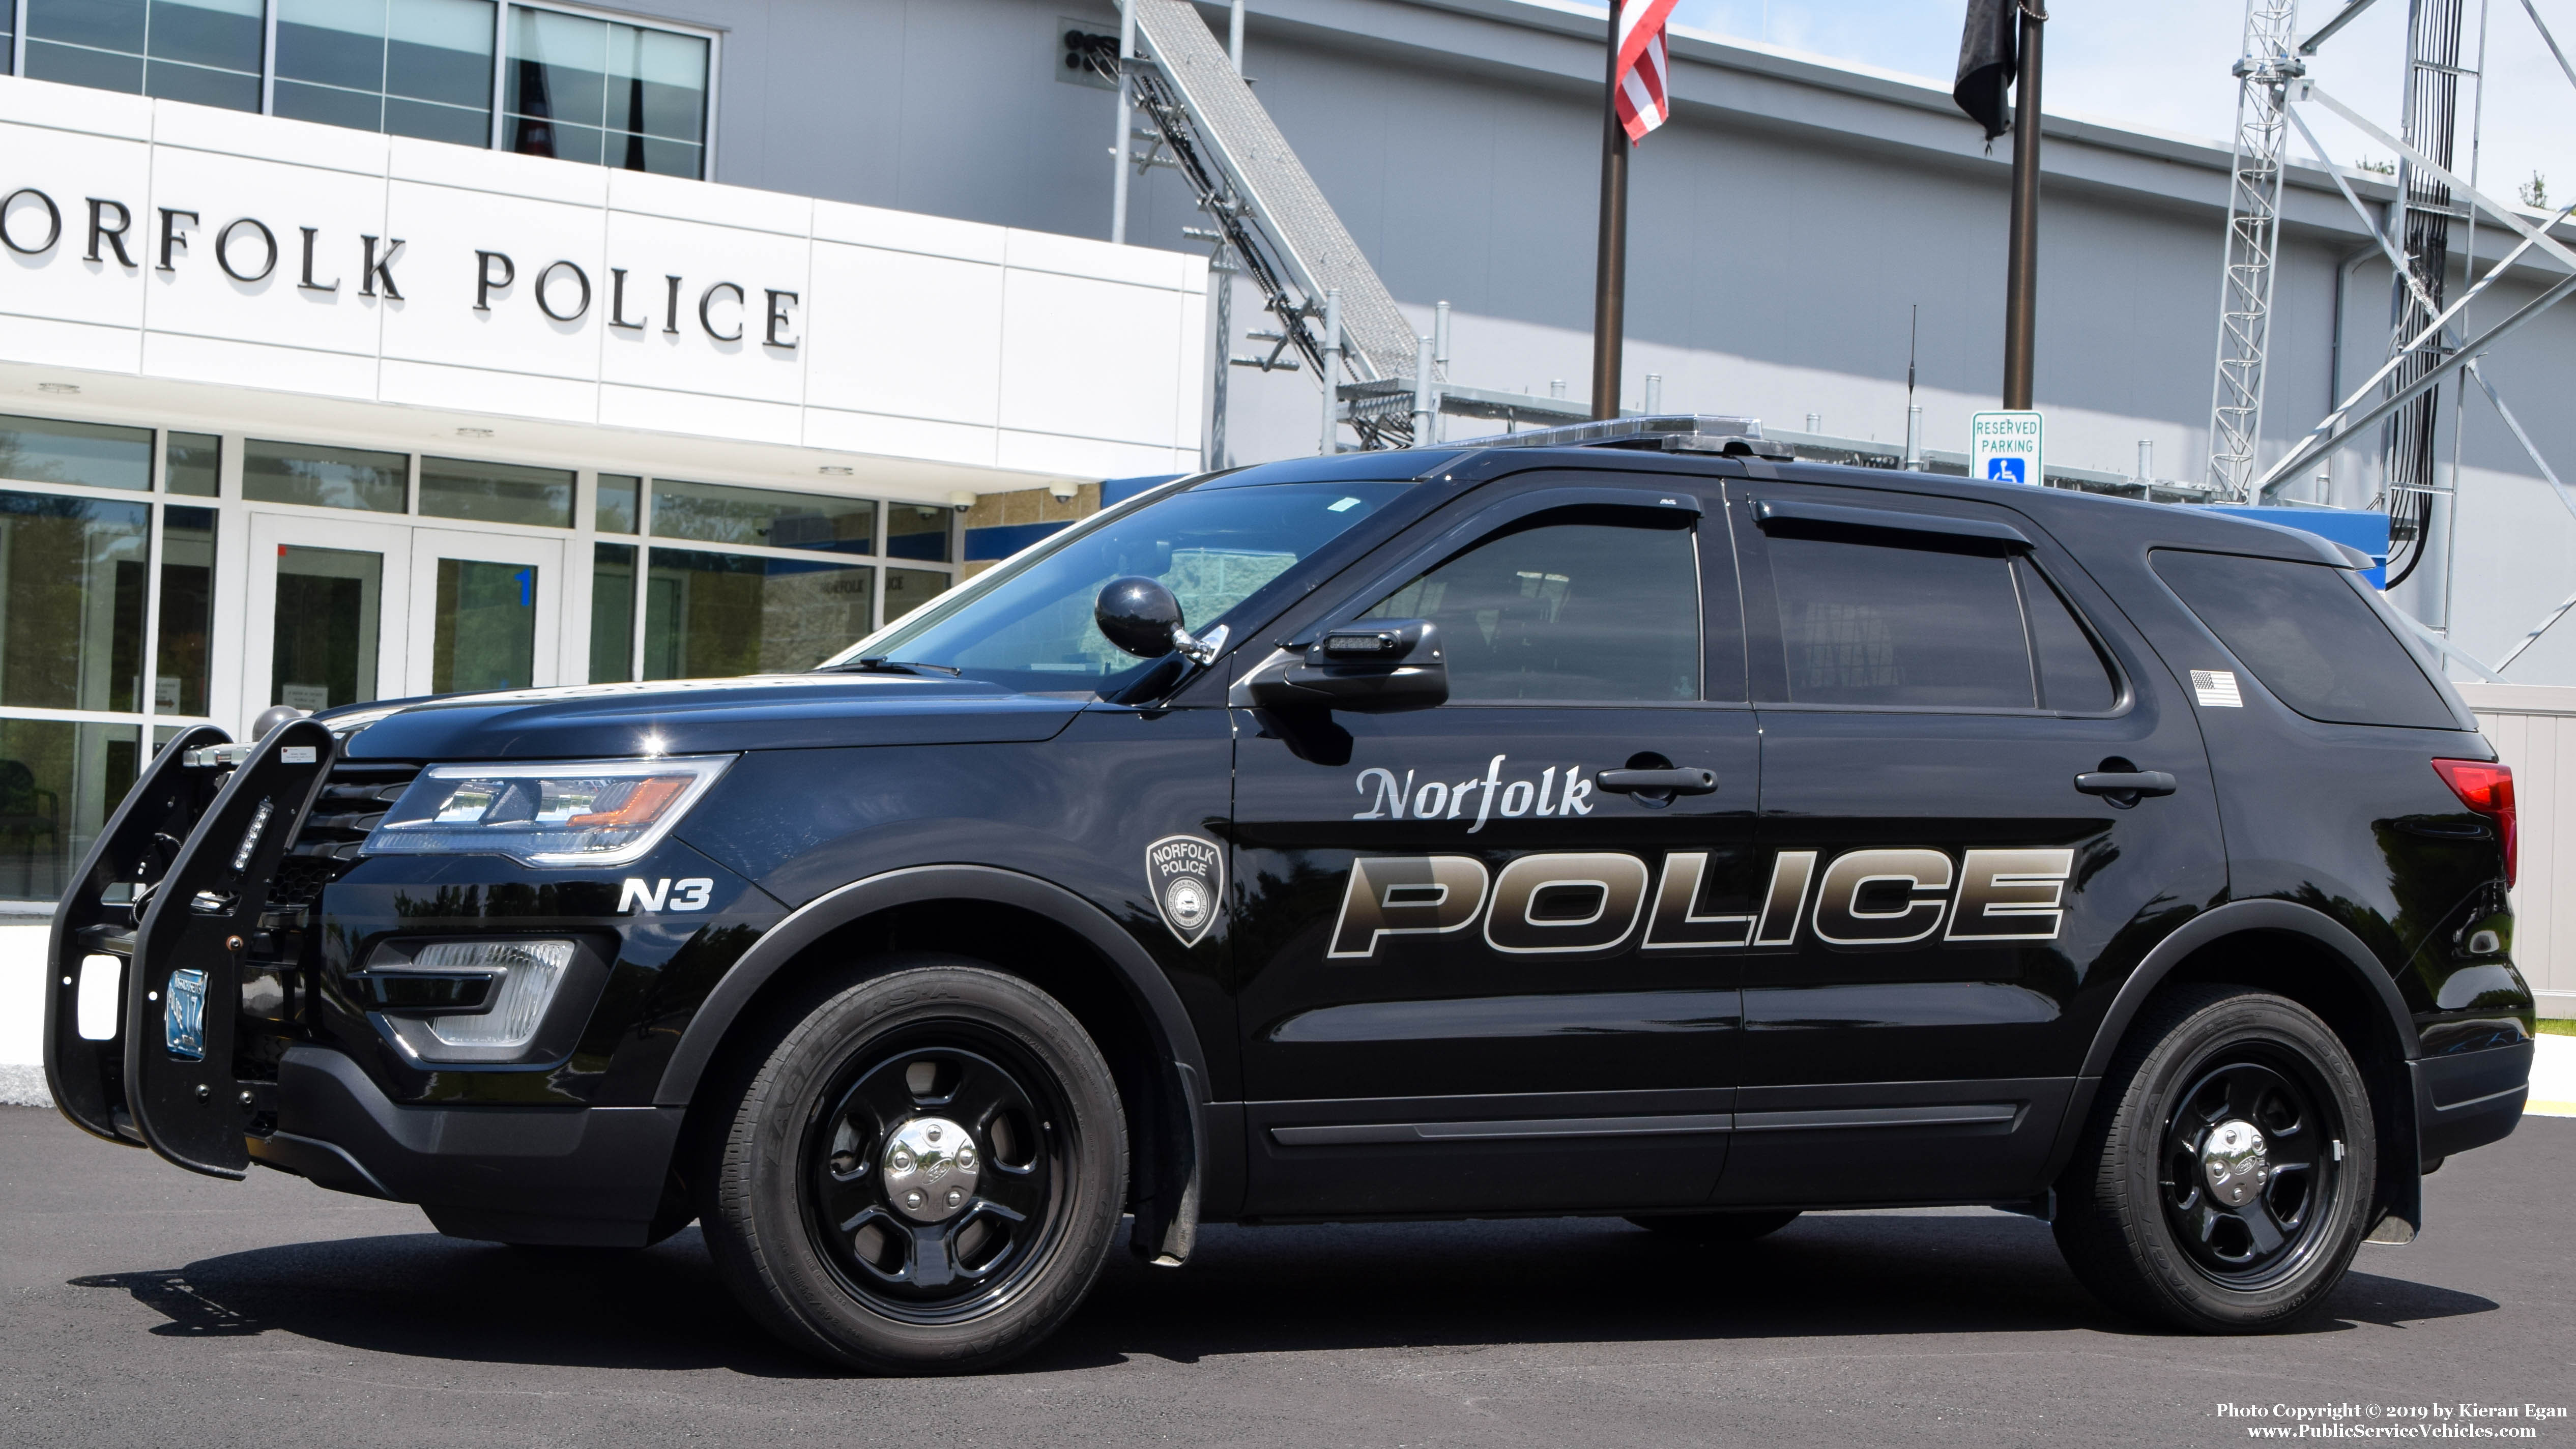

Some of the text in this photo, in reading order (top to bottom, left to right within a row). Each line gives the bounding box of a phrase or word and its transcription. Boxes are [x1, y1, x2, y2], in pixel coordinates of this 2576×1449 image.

[0, 189, 800, 349] ORFOLK POLICE
[1977, 422, 2037, 434] RESERVED
[1982, 440, 2033, 452] PARKING
[1353, 755, 1594, 833] Norfolk
[1152, 843, 1214, 865] NORFOLK
[1161, 860, 1207, 877] POLICE
[617, 878, 713, 912] N3
[1327, 849, 2074, 959] POLICE
[938, 1187, 1111, 1359] GOODYEAR
